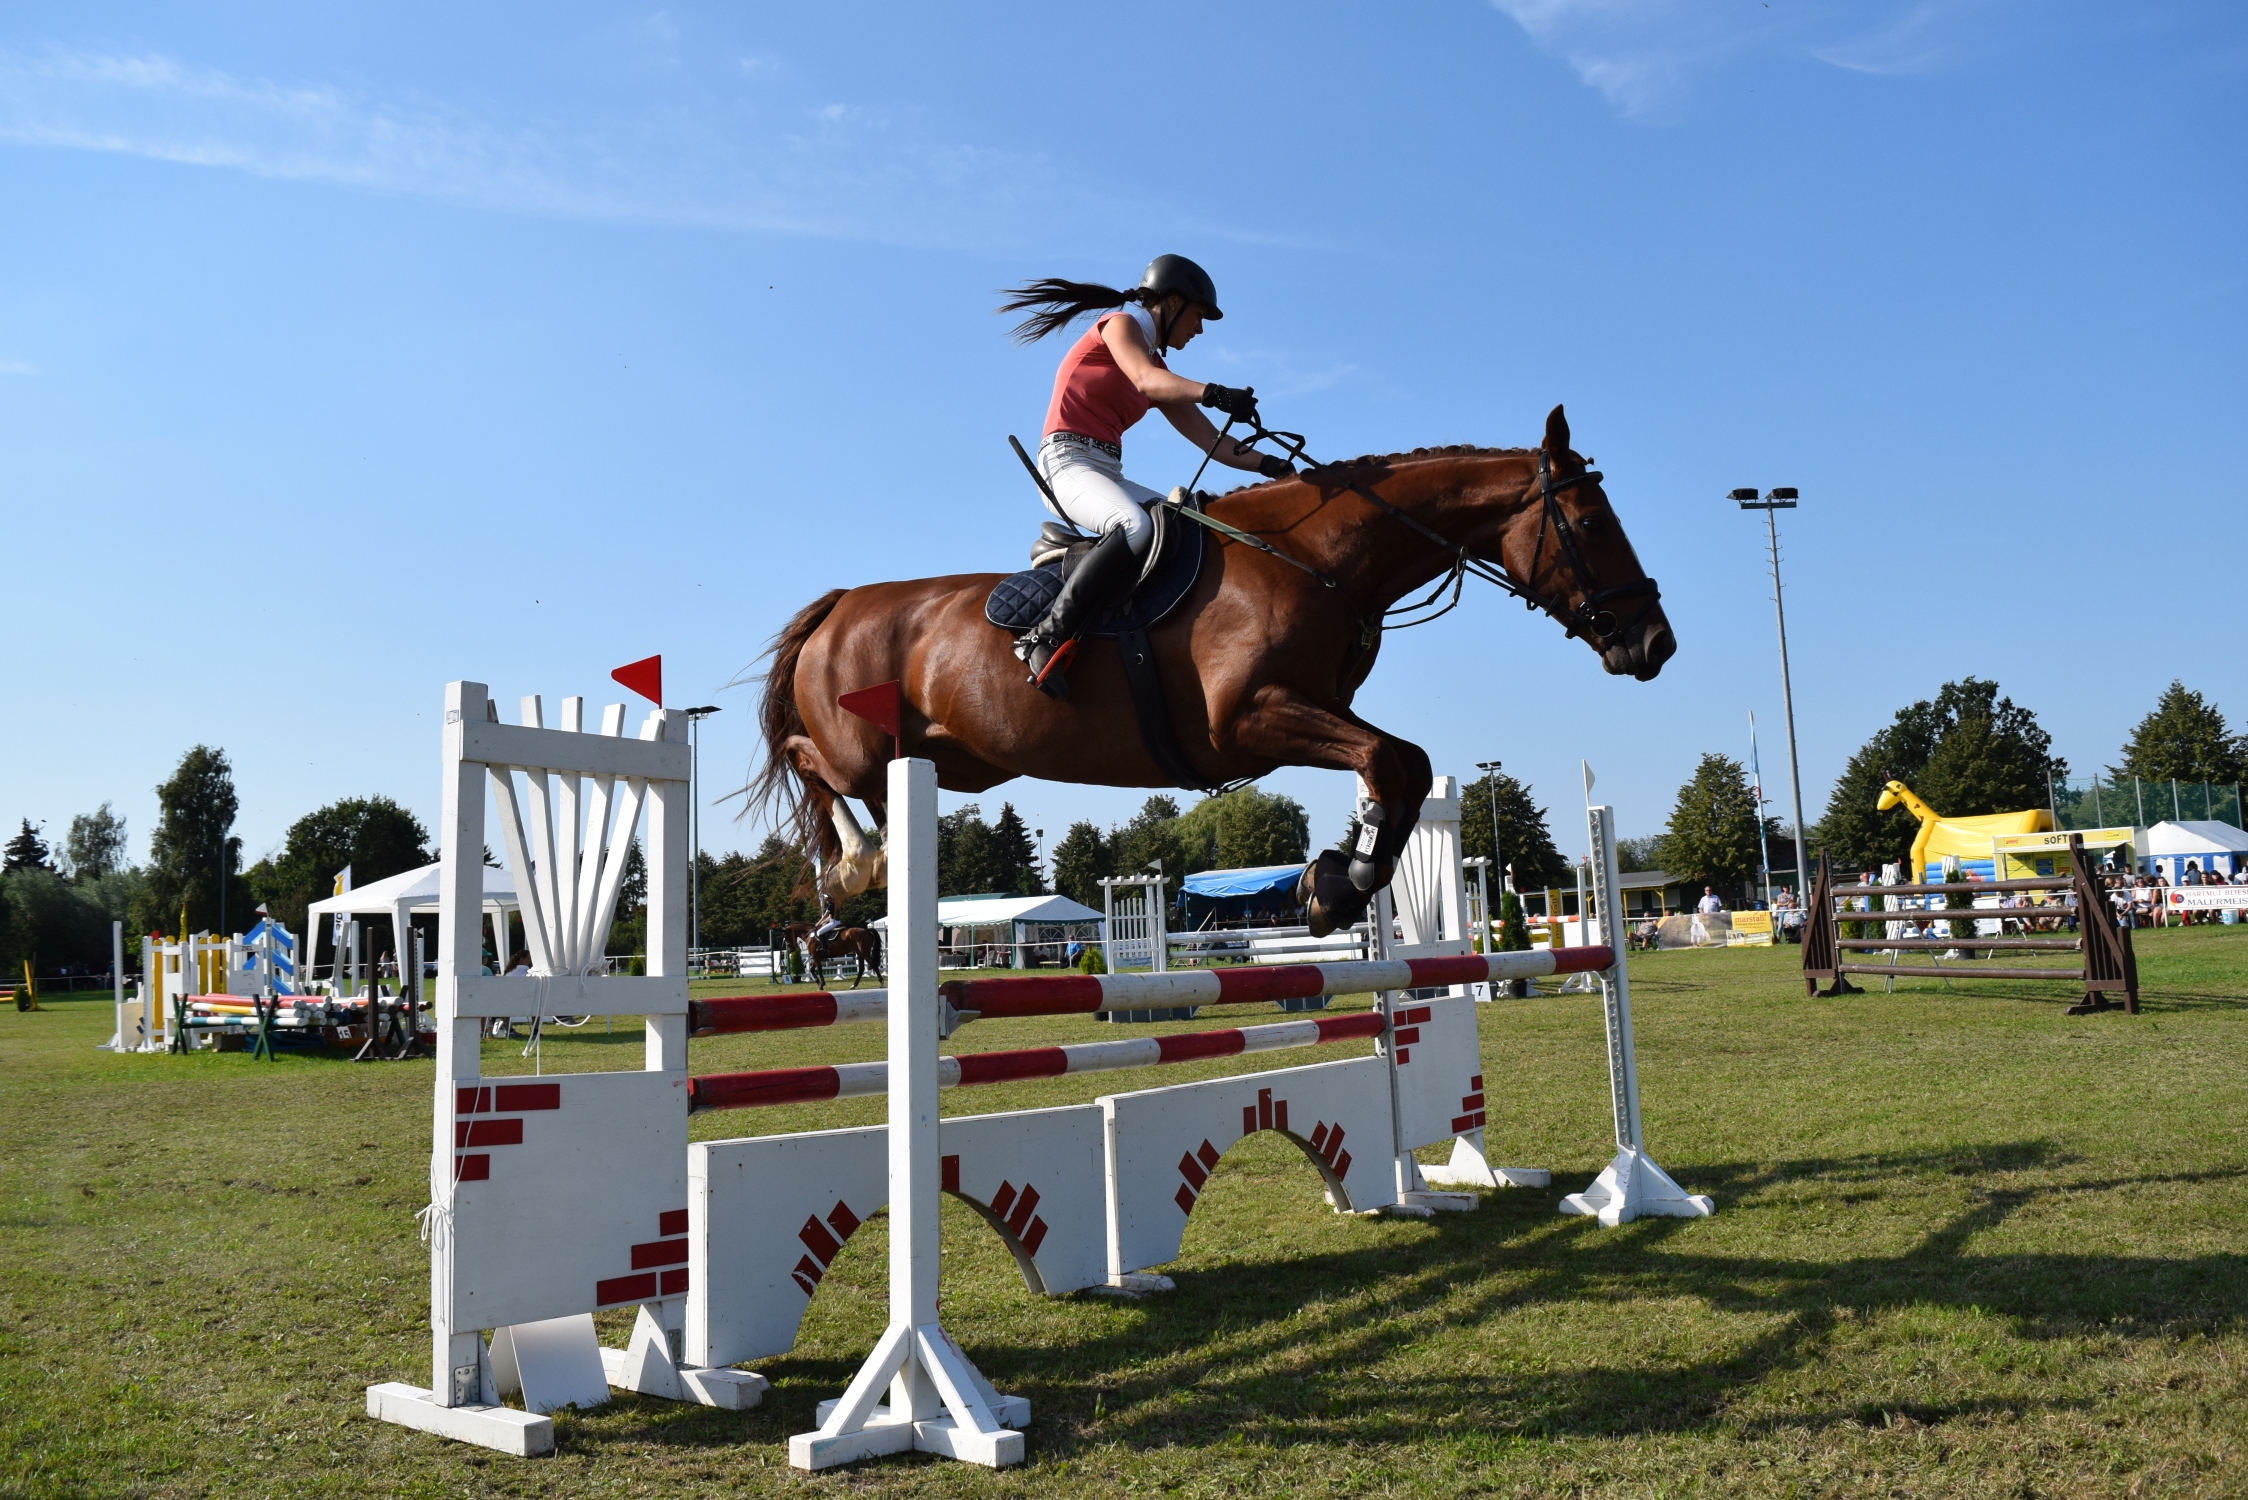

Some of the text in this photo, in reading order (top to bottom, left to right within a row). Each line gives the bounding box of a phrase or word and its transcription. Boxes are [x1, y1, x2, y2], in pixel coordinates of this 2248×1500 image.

[2044, 835, 2071, 844] SOFT
[1735, 914, 1765, 923] marstall
[1475, 985, 1483, 996] 7
[340, 1030, 350, 1039] 15
